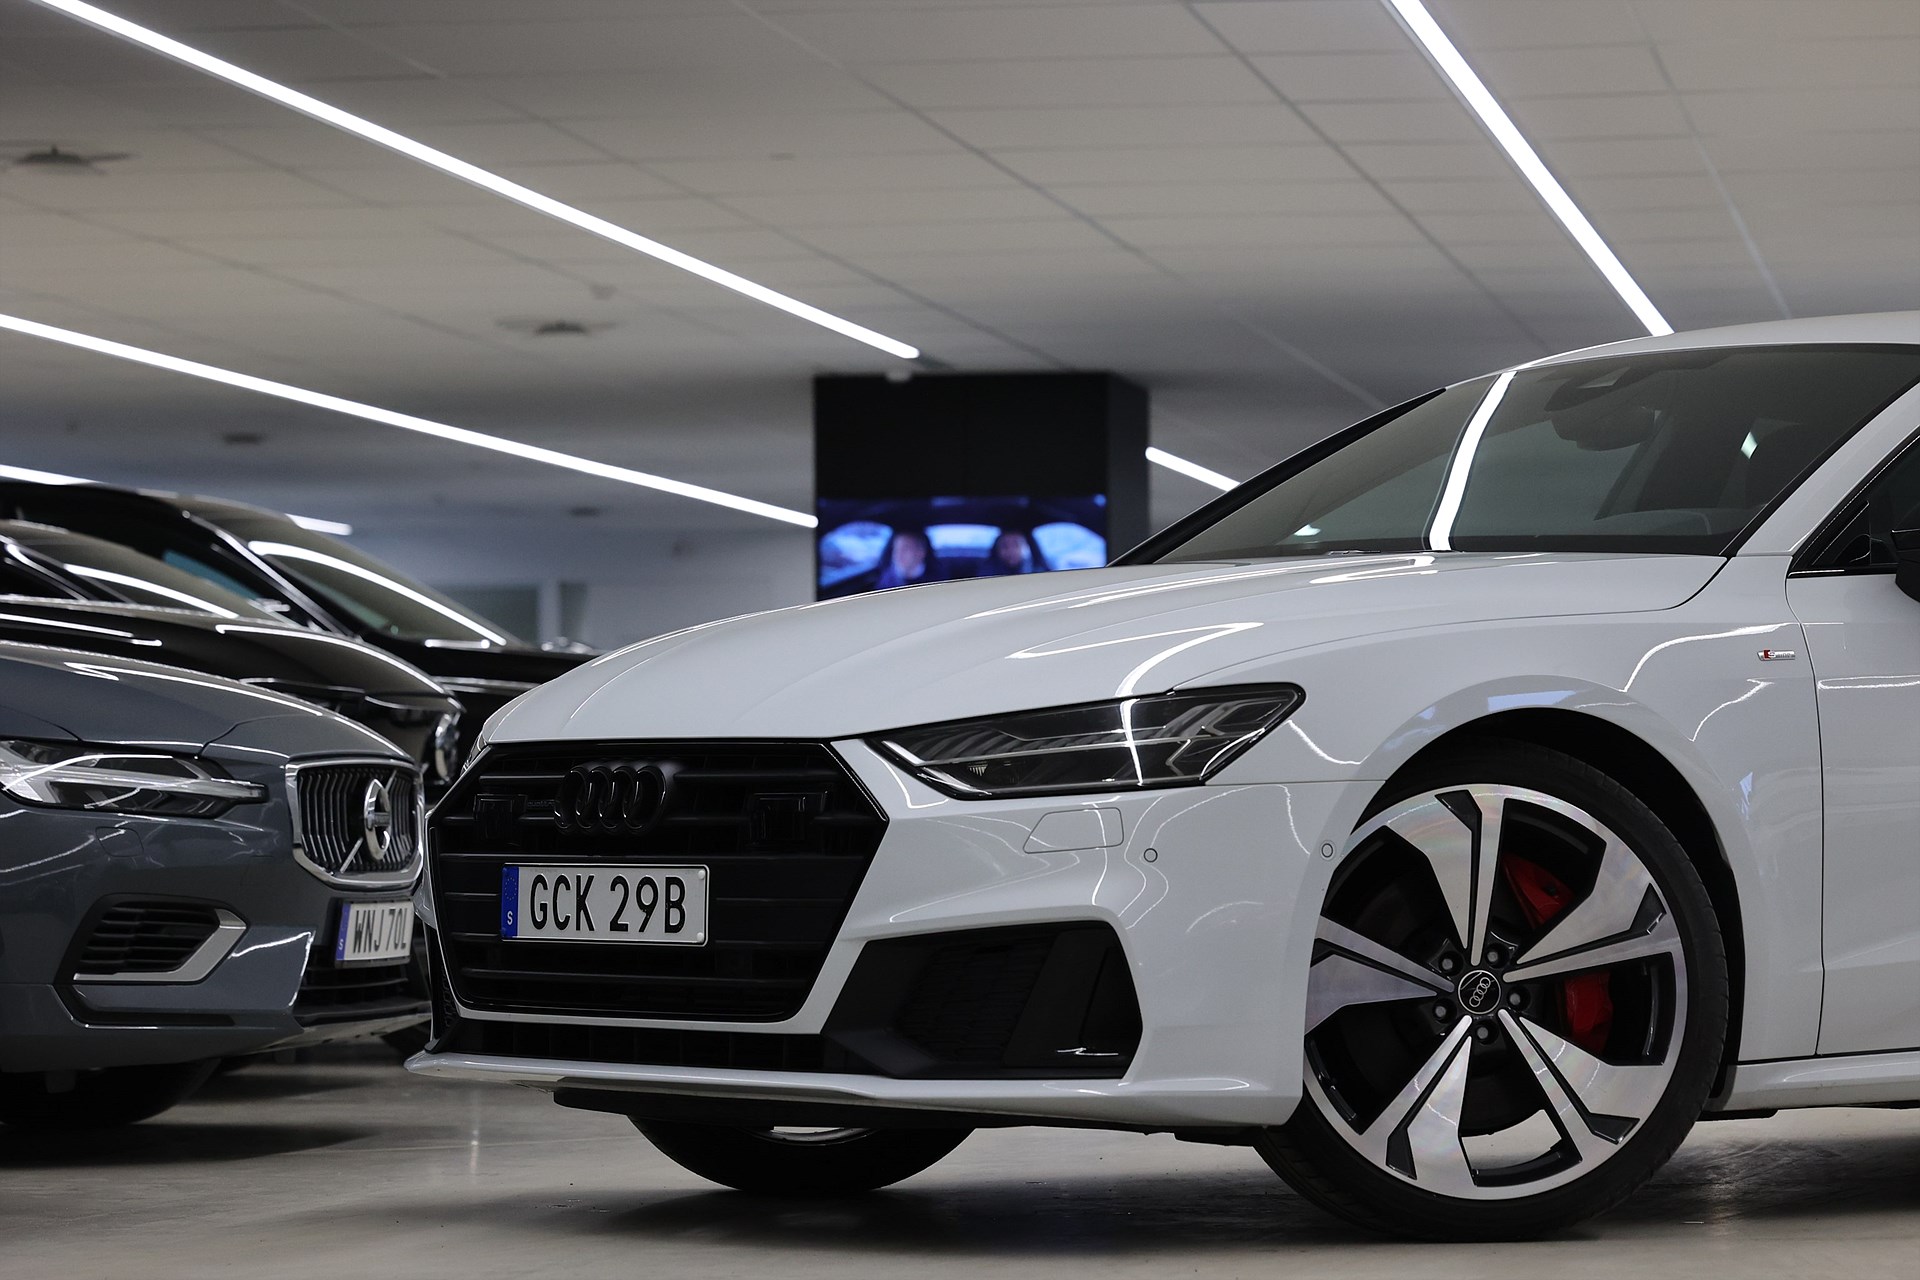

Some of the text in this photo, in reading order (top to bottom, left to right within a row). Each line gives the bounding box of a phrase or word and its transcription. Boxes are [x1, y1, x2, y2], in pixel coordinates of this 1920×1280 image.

[506, 910, 513, 926] S
[530, 873, 686, 934] GCK 29B
[338, 938, 344, 950] S
[353, 907, 407, 953] WNJ 70L
